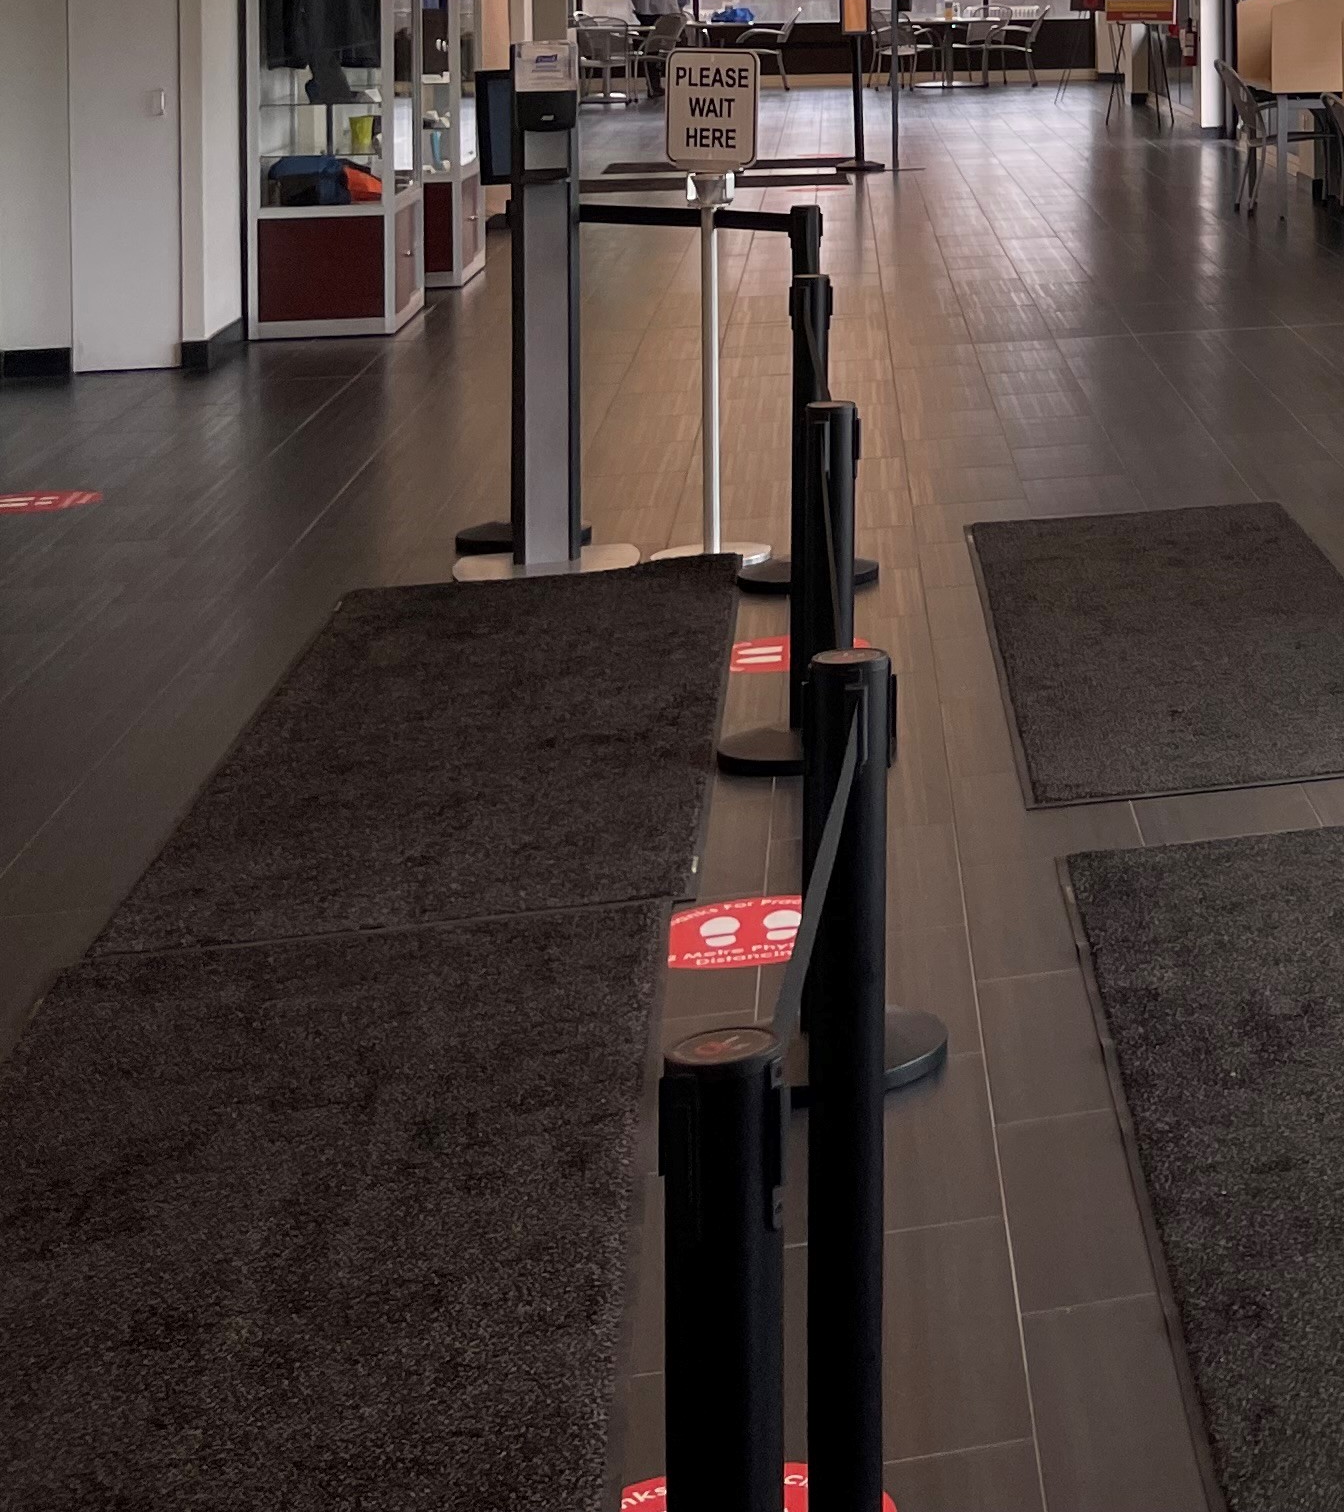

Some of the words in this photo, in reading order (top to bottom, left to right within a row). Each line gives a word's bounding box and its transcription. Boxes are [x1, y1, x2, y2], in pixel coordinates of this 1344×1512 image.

[675, 66, 750, 89] PLEASE
[688, 96, 736, 118] WAIT
[685, 127, 737, 149] HERE
[696, 949, 792, 966] Distancin
